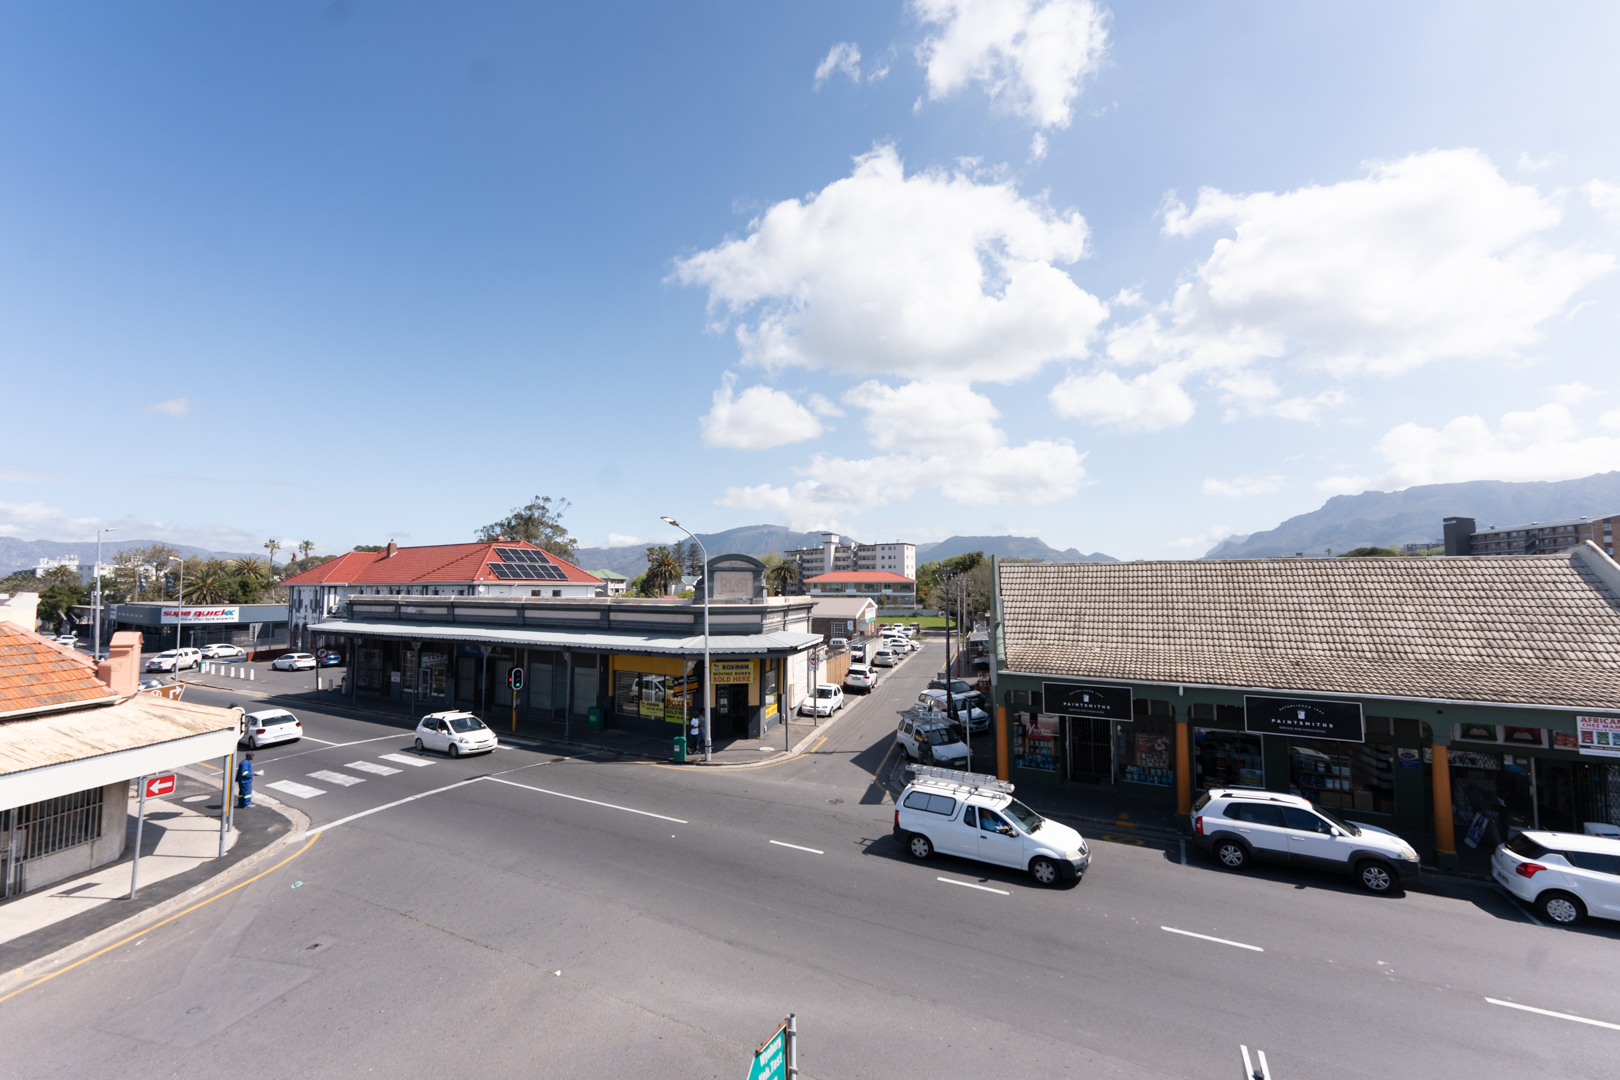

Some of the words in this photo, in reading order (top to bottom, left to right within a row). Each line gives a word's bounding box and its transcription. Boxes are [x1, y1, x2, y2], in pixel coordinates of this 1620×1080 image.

[163, 610, 191, 618] supa
[193, 609, 235, 618] quick
[1272, 719, 1334, 728] PAINTSMITHS
[760, 1036, 782, 1067] Wynberg
[770, 1052, 782, 1073] Test
